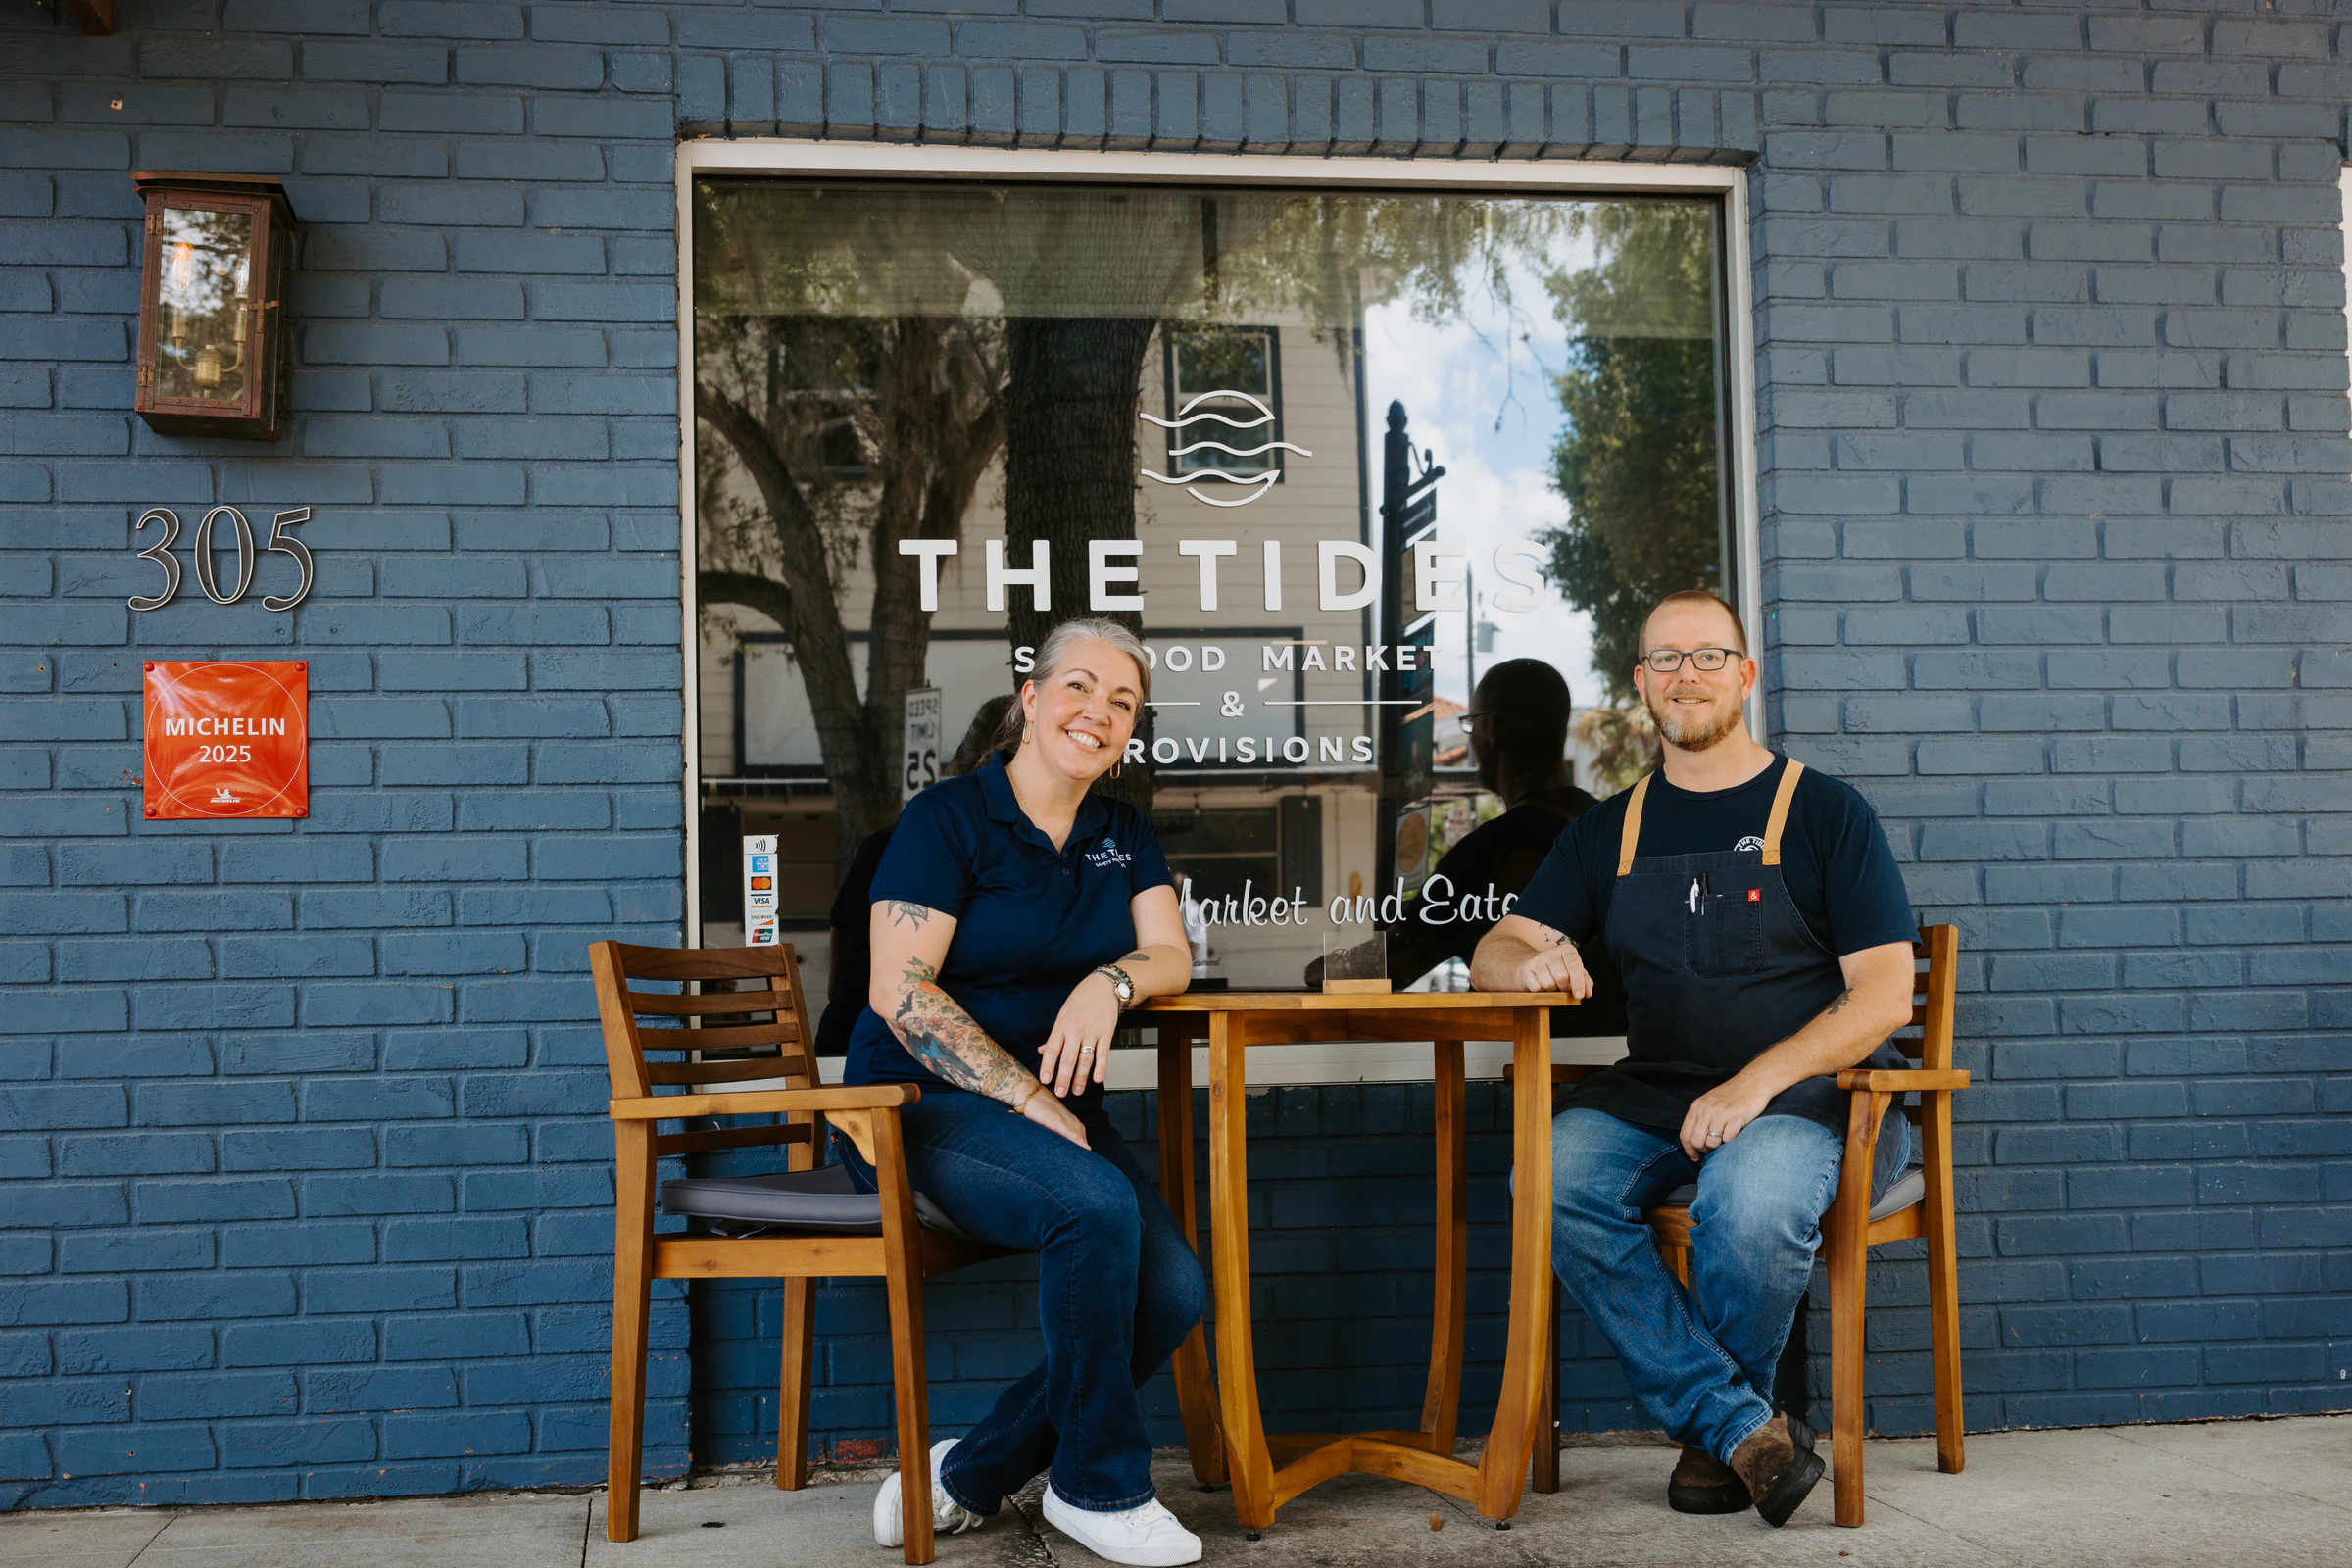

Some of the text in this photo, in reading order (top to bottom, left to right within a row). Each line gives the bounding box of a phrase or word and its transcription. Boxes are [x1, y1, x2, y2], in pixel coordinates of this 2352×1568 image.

[128, 506, 314, 612] 305
[899, 539, 1548, 613] THE TIDES
[1261, 644, 1444, 672] MARKET
[1219, 690, 1245, 717] &
[165, 717, 285, 736] MICHELIN
[199, 745, 252, 763] 2025
[1123, 736, 1373, 763] ROVISIONS
[1107, 849, 1132, 861] TIES
[1328, 877, 1407, 925] and
